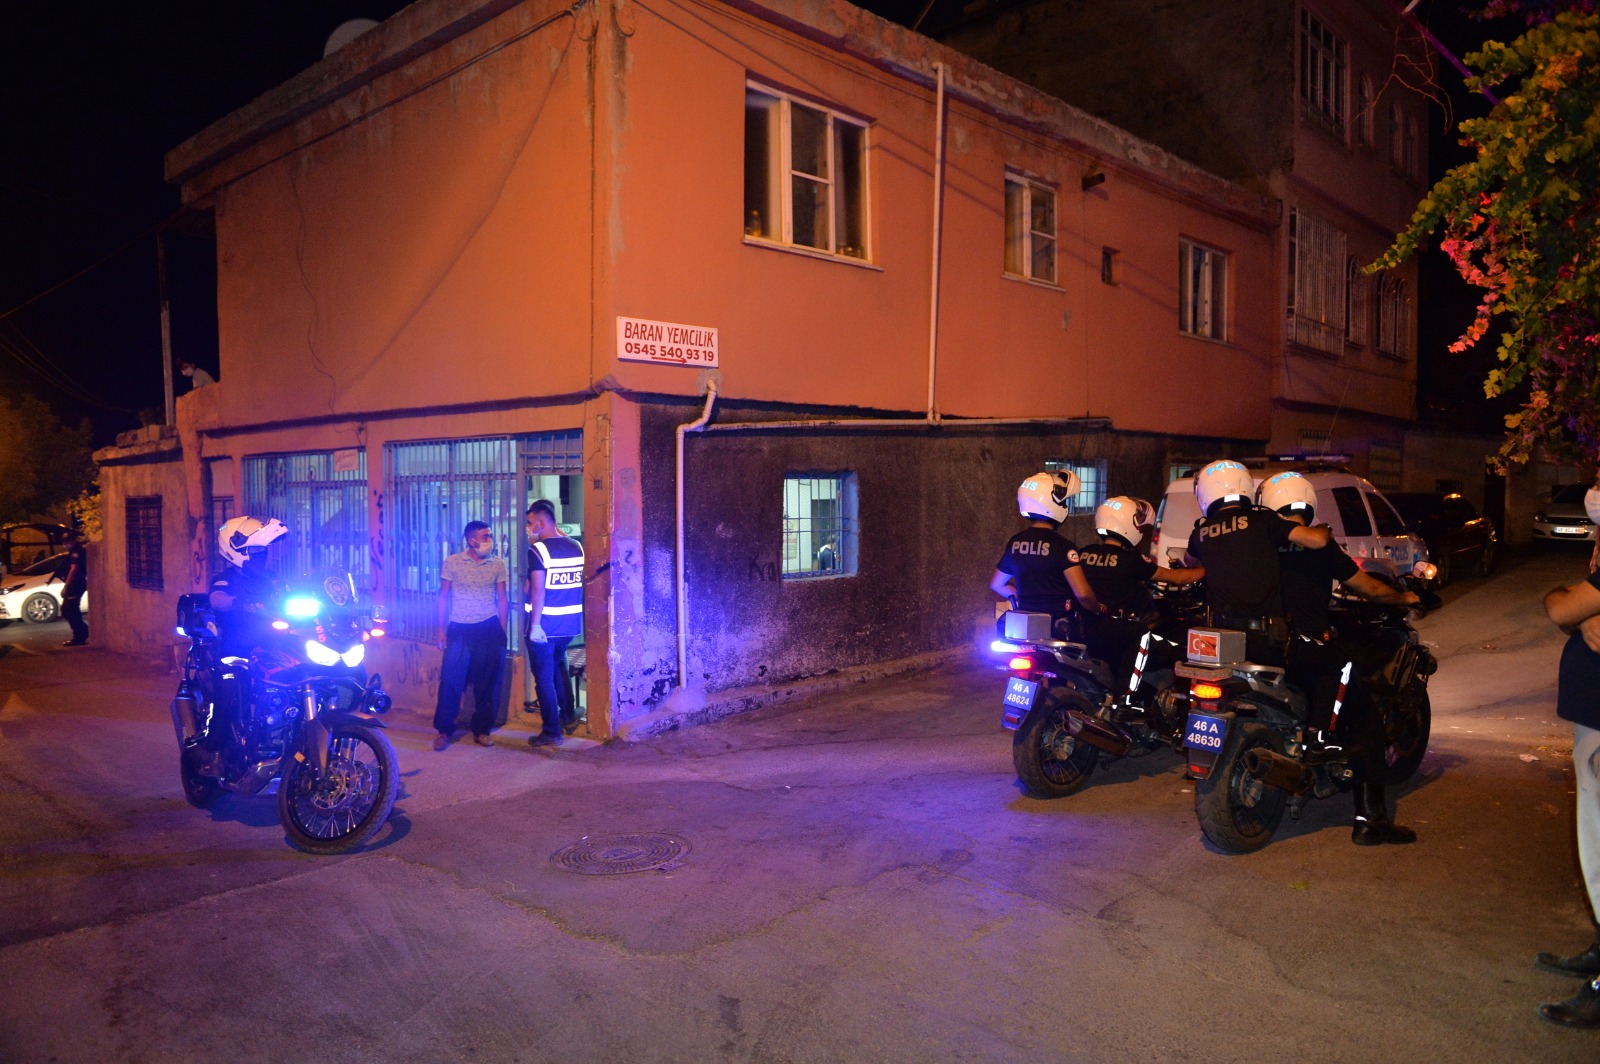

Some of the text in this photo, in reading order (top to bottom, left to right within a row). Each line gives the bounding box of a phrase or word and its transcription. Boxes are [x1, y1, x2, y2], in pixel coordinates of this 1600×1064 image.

[624, 321, 714, 348] BARAN YEMCİLİK
[625, 342, 714, 361] 0545 540 93 19
[1011, 540, 1050, 556] POLİS
[1080, 551, 1118, 567] POLİS
[551, 572, 582, 584] POLİS
[1012, 681, 1029, 695] 46 A
[1006, 692, 1030, 706] 48624
[1193, 720, 1218, 734] 46 A
[1187, 733, 1221, 748] 48630
